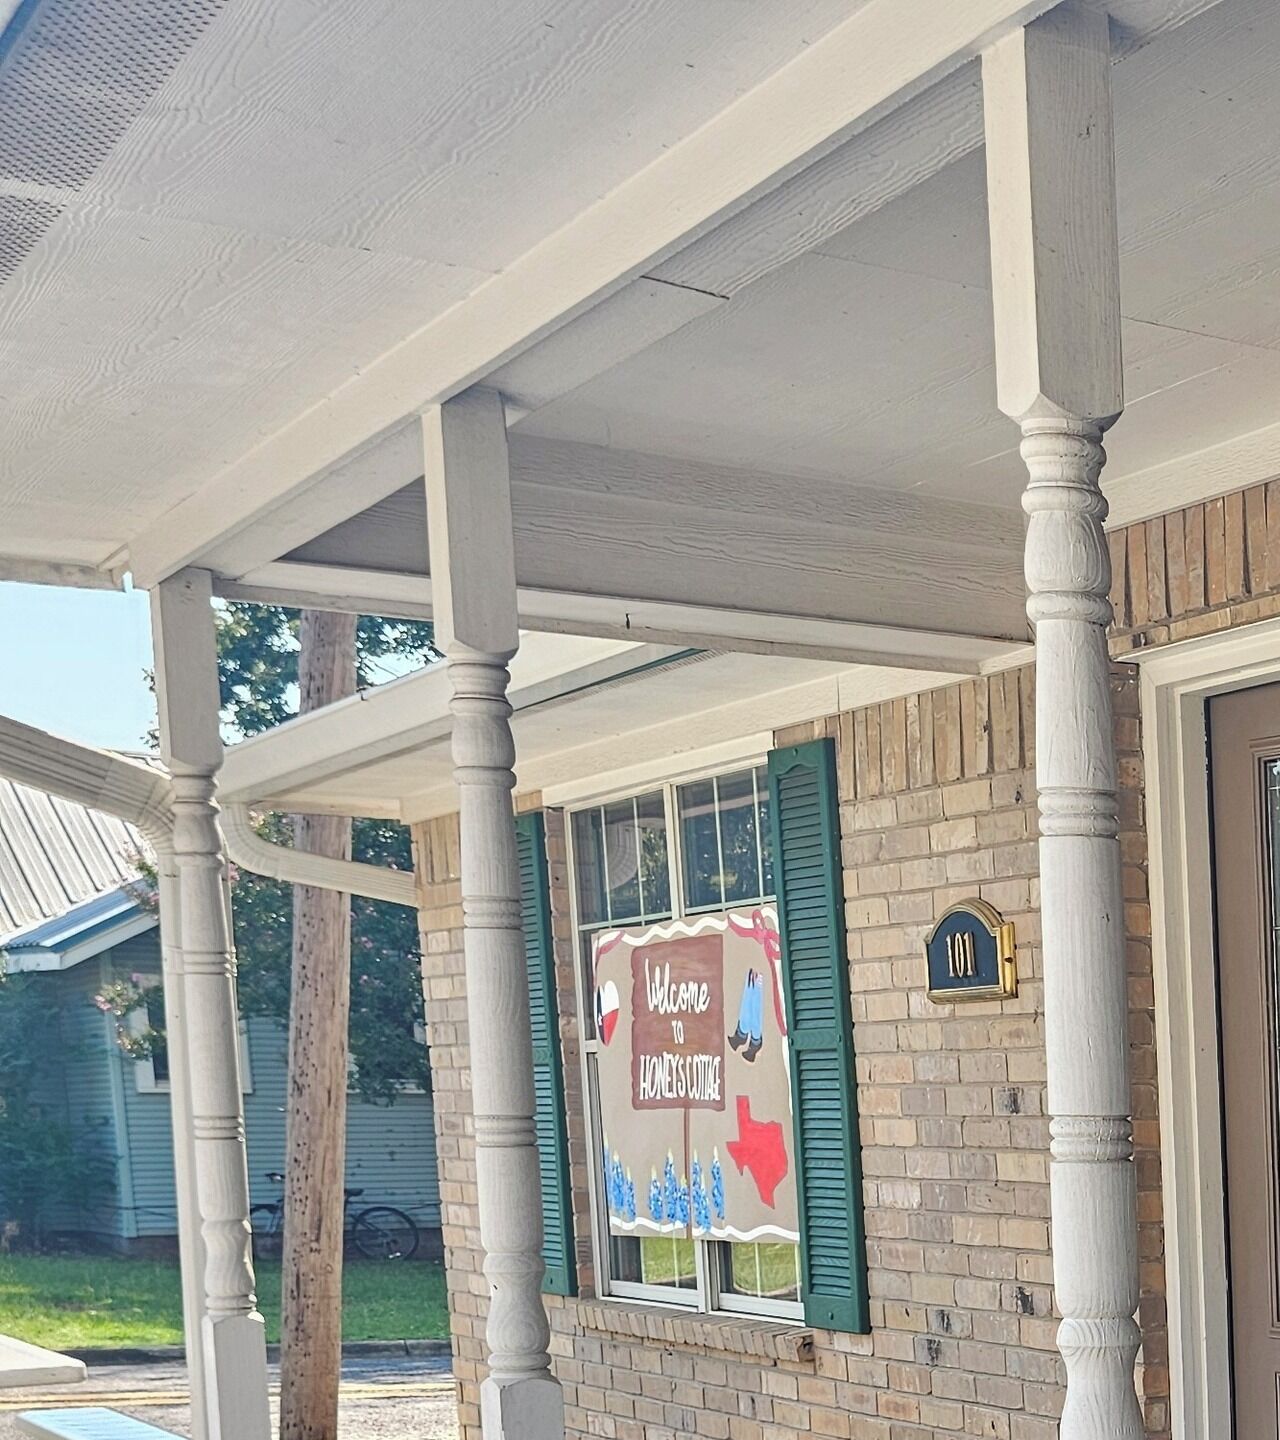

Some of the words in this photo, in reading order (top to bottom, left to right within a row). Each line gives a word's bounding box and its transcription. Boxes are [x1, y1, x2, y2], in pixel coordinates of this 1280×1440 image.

[945, 931, 975, 978] 101
[644, 957, 711, 1015] Welcome
[671, 1019, 685, 1044] TO
[685, 1053, 722, 1101] COTTAGE
